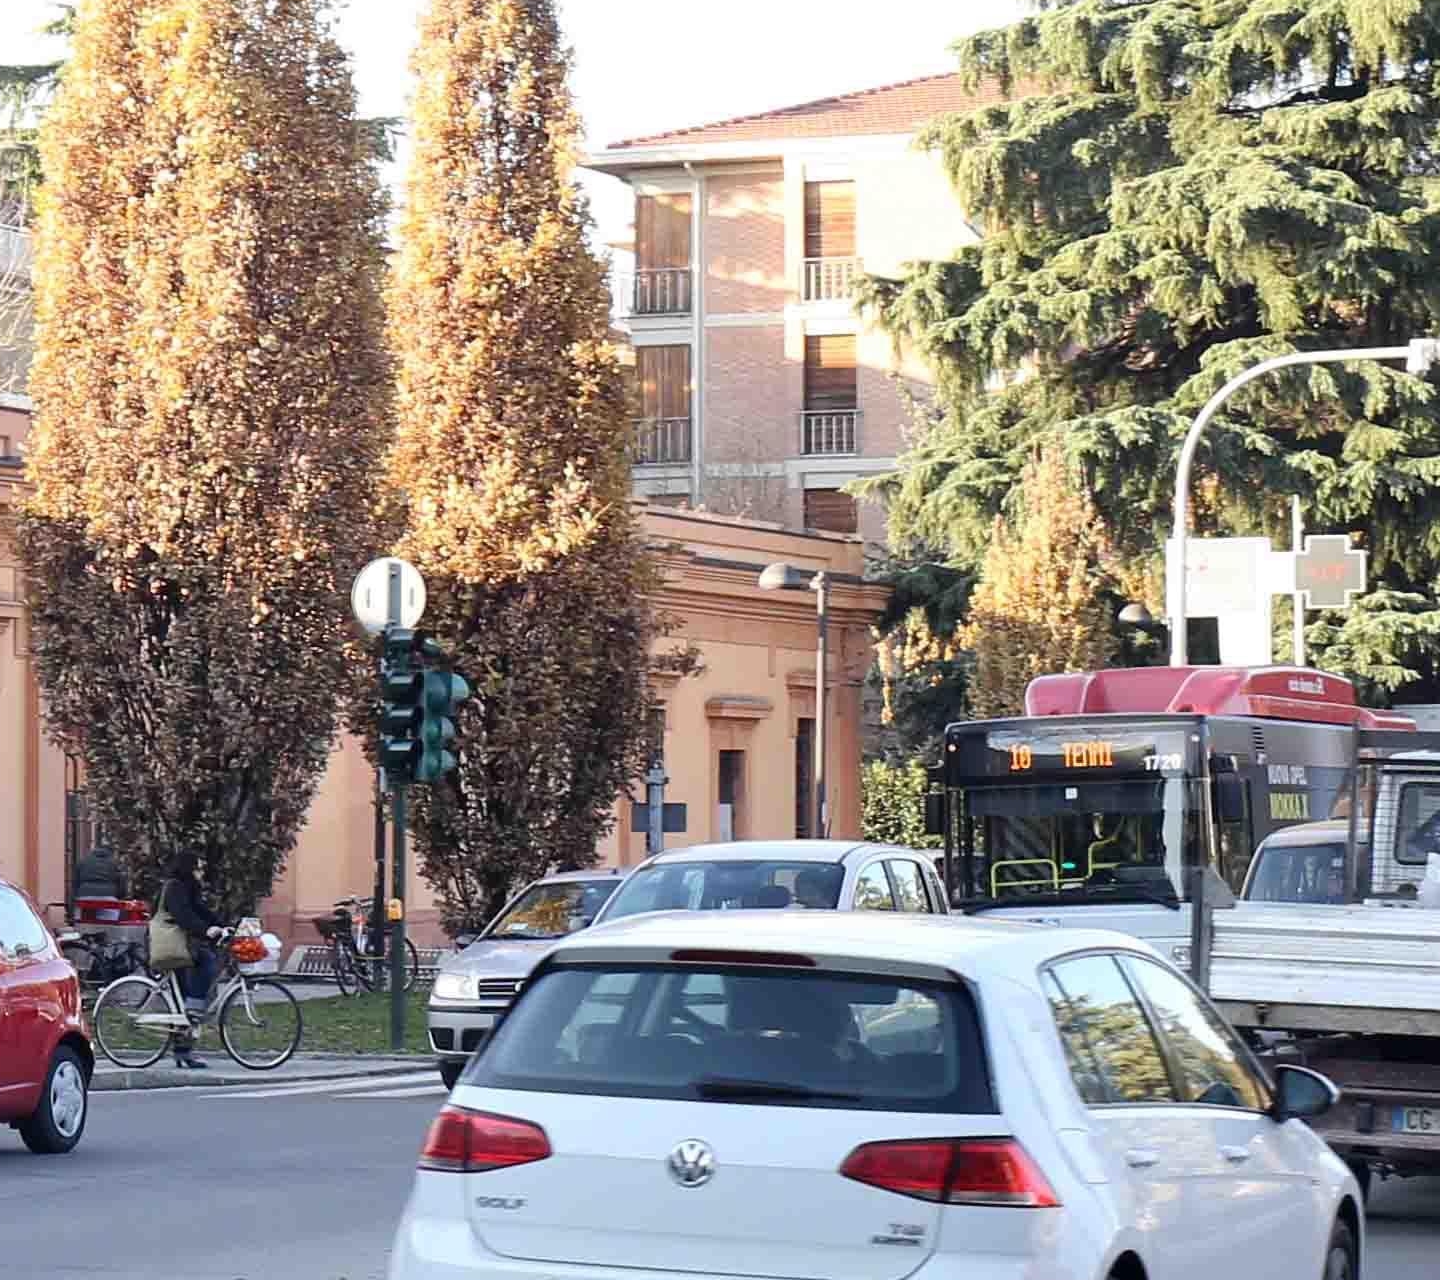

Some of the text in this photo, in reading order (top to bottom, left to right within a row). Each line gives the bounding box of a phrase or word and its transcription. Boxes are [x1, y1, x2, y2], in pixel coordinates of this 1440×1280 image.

[1008, 743, 1032, 771] 10
[1143, 754, 1183, 771] 1720
[1407, 1108, 1433, 1130] CG
[475, 1195, 528, 1210] GOLF
